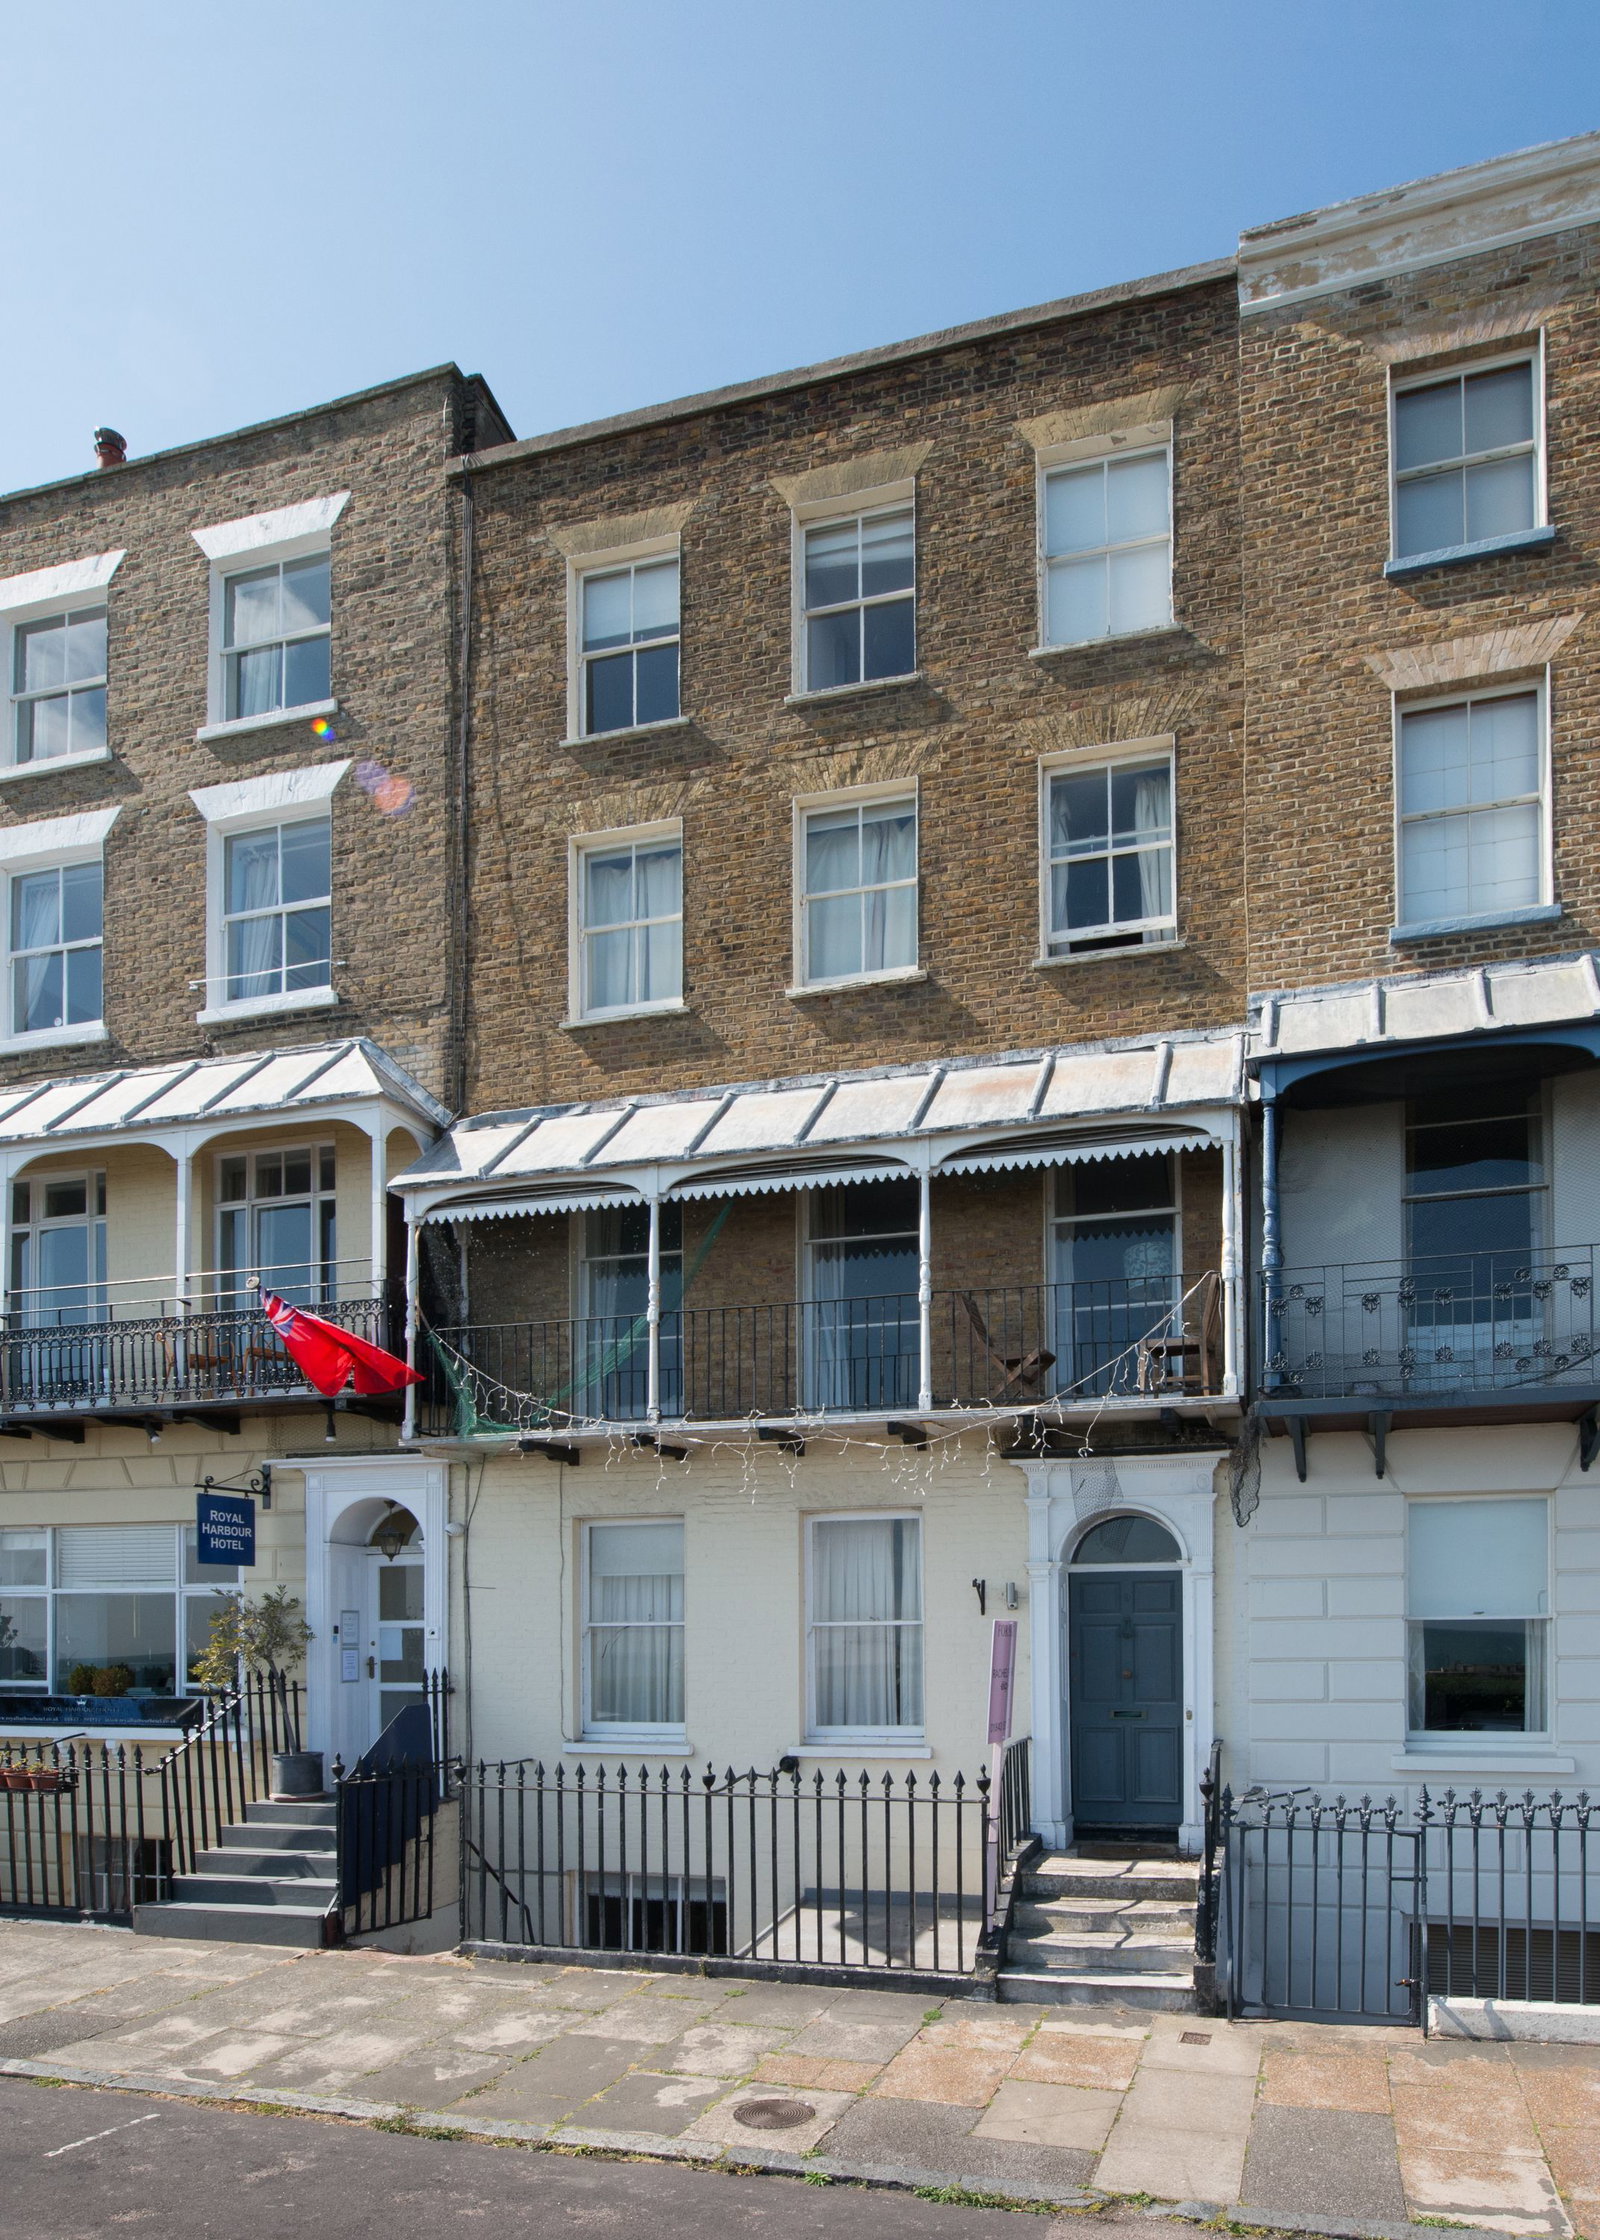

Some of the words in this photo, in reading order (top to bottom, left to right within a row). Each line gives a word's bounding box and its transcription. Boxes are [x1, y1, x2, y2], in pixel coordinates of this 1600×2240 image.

[210, 1510, 245, 1524] ROYAL
[202, 1523, 252, 1537] HARBOUR
[210, 1537, 244, 1550] HOTEL
